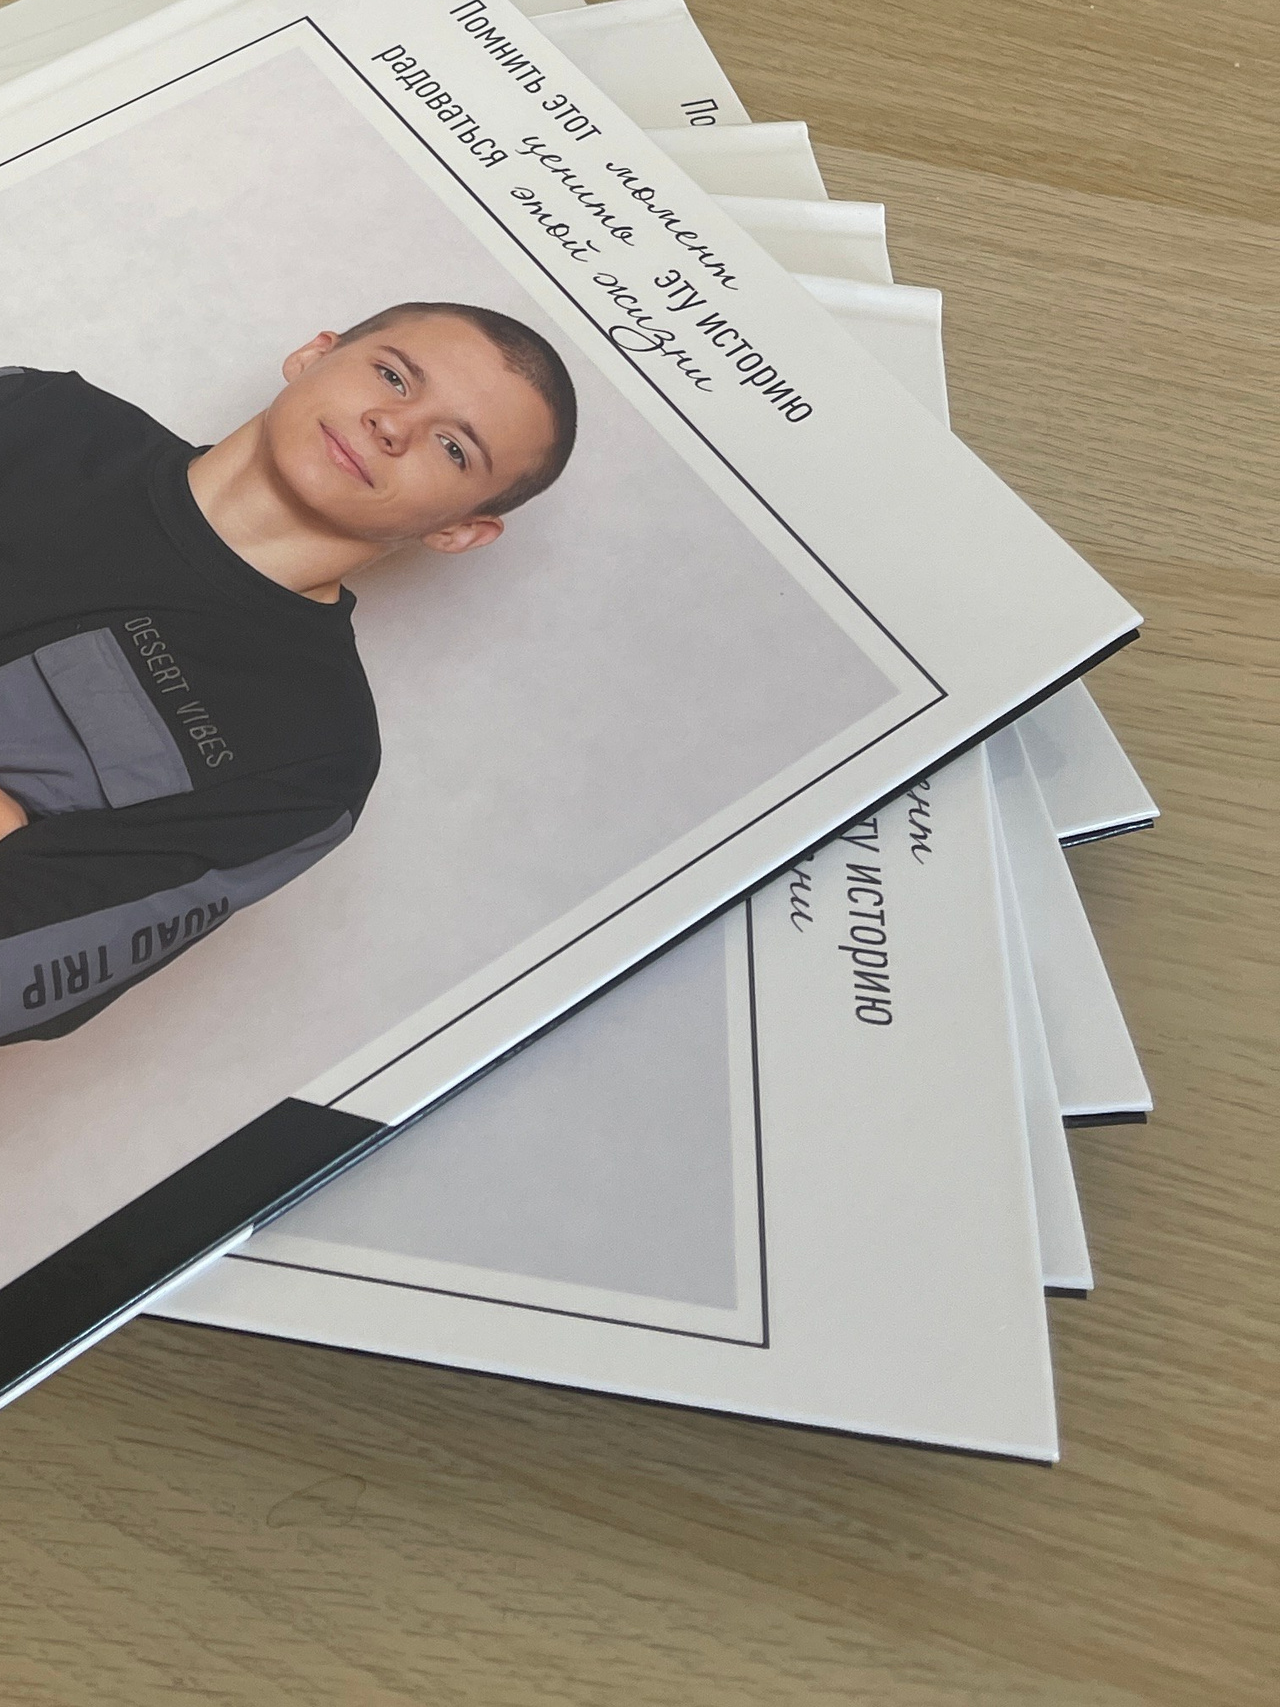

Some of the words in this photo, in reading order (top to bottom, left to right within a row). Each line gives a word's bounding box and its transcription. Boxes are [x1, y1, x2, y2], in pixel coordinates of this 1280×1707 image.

[371, 44, 509, 169] радоваться
[510, 186, 601, 263] этой
[592, 271, 715, 393] жизни
[514, 134, 635, 247] ценить
[653, 268, 707, 313] эту
[695, 310, 815, 424] историю
[541, 93, 602, 143] этот
[605, 160, 740, 291] момент
[124, 615, 190, 696] DESERT
[175, 700, 234, 769] VIBES
[23, 945, 115, 1010] TRIP
[837, 862, 894, 1026] историю
